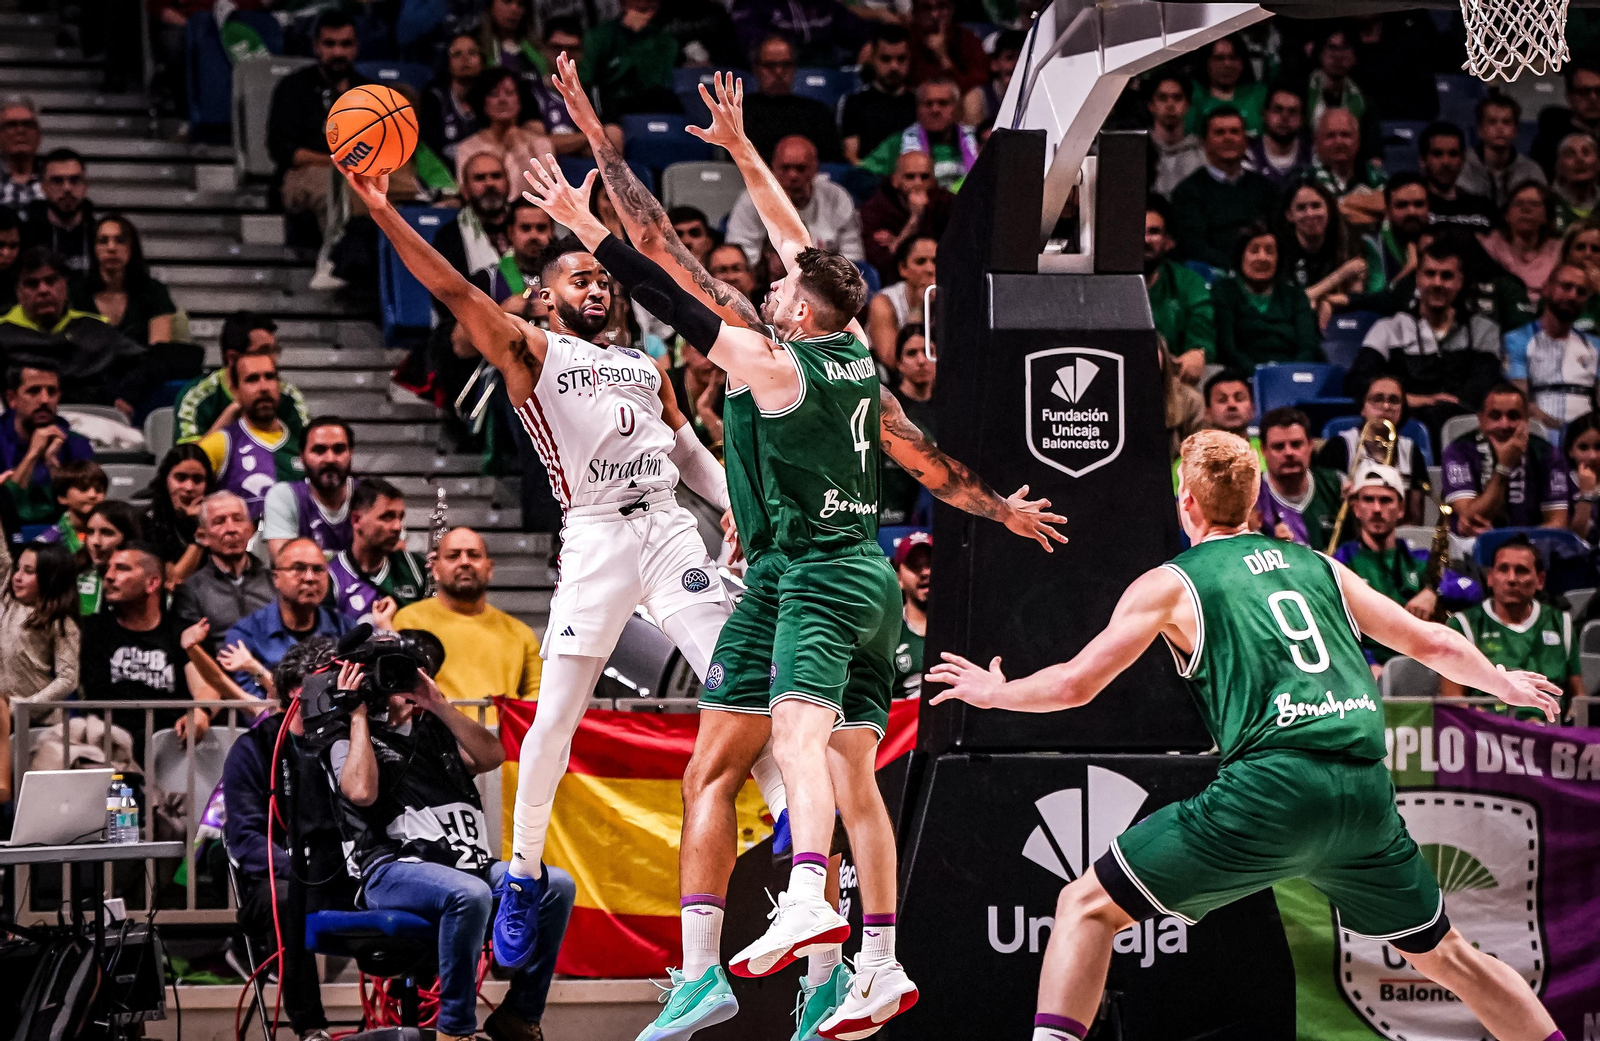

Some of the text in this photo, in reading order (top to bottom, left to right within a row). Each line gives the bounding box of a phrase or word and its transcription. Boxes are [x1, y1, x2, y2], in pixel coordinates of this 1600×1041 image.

[614, 401, 636, 437] 0
[1042, 407, 1109, 422] Fundación
[850, 397, 872, 473] 4
[1042, 437, 1110, 450] Baloncesto
[1052, 423, 1100, 440] Unicaja
[1242, 548, 1290, 576] DÍAZ
[1267, 590, 1331, 674] 9
[1475, 730, 1544, 777] DEL
[435, 810, 479, 841] HB
[987, 905, 1188, 968] Unaja
